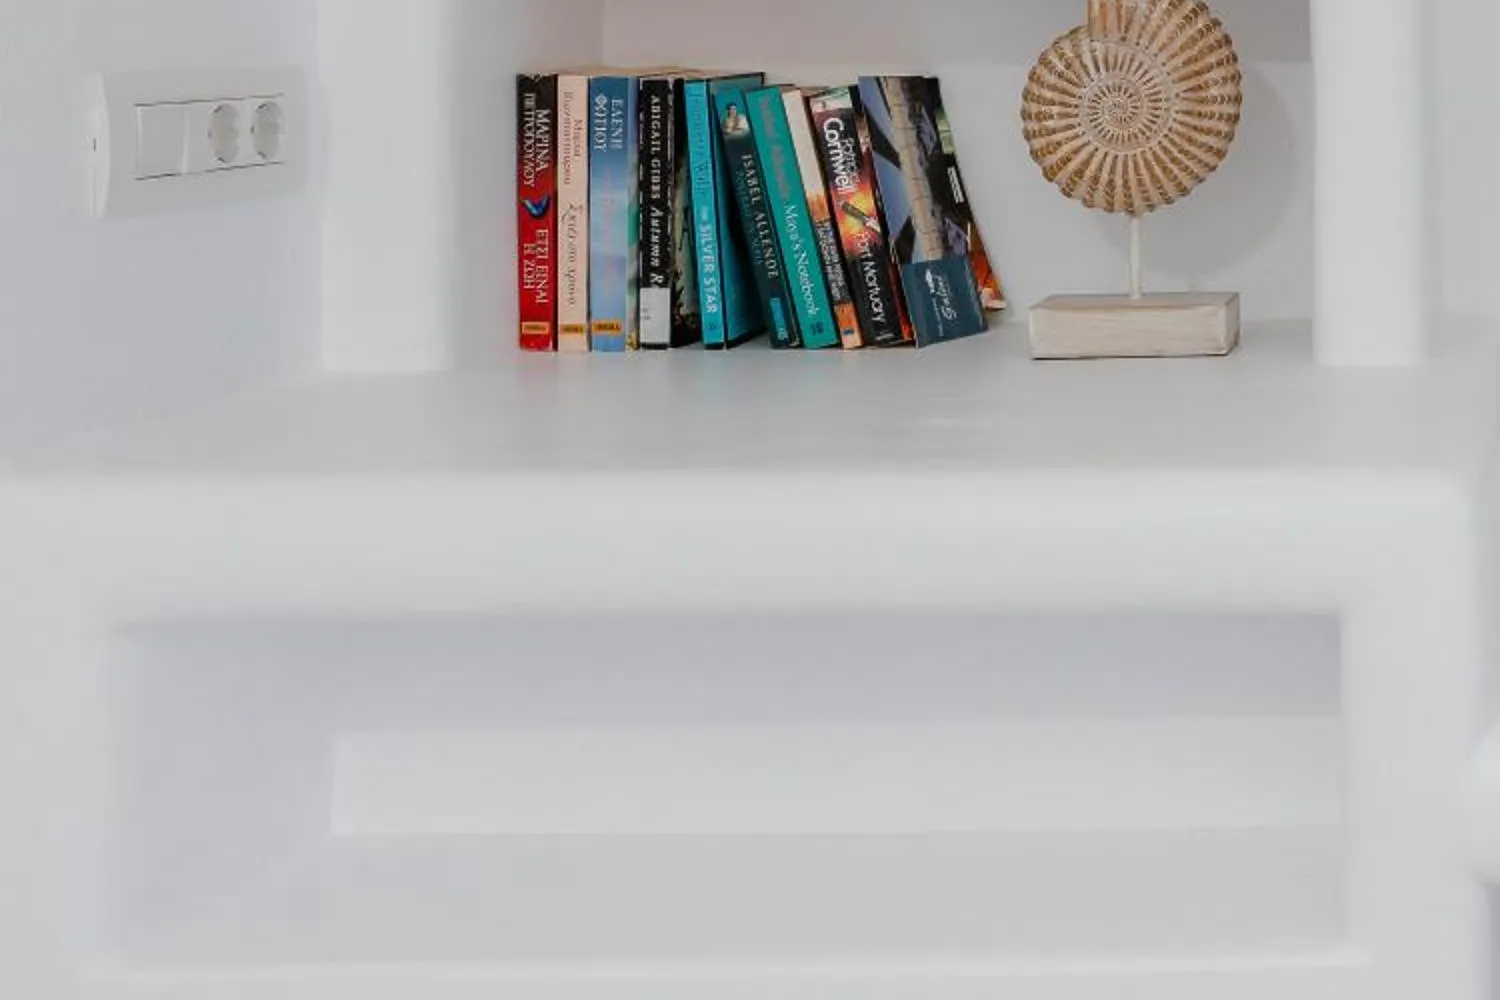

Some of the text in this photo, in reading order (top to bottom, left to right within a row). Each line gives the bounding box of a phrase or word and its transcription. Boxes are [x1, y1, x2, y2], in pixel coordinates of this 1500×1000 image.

[535, 108, 549, 172] ΜΑΡΙΝΑ
[610, 97, 624, 149] ΕΛΕΝΗ
[650, 95, 662, 154] ABIGAIL
[650, 158, 662, 200] GIBBS
[823, 116, 850, 194] Cornwell
[649, 206, 665, 268] Autumn
[740, 153, 763, 205] ISABEL
[753, 209, 780, 279] ALLENDE
[523, 259, 535, 289] ΖΩΗ
[700, 223, 715, 272] SILVER
[783, 203, 804, 252] Maya's
[794, 250, 820, 316] Notebook
[535, 264, 549, 304] ΕΙΝΑΙ
[703, 275, 719, 314] STAR
[861, 261, 887, 324] Mortuary
